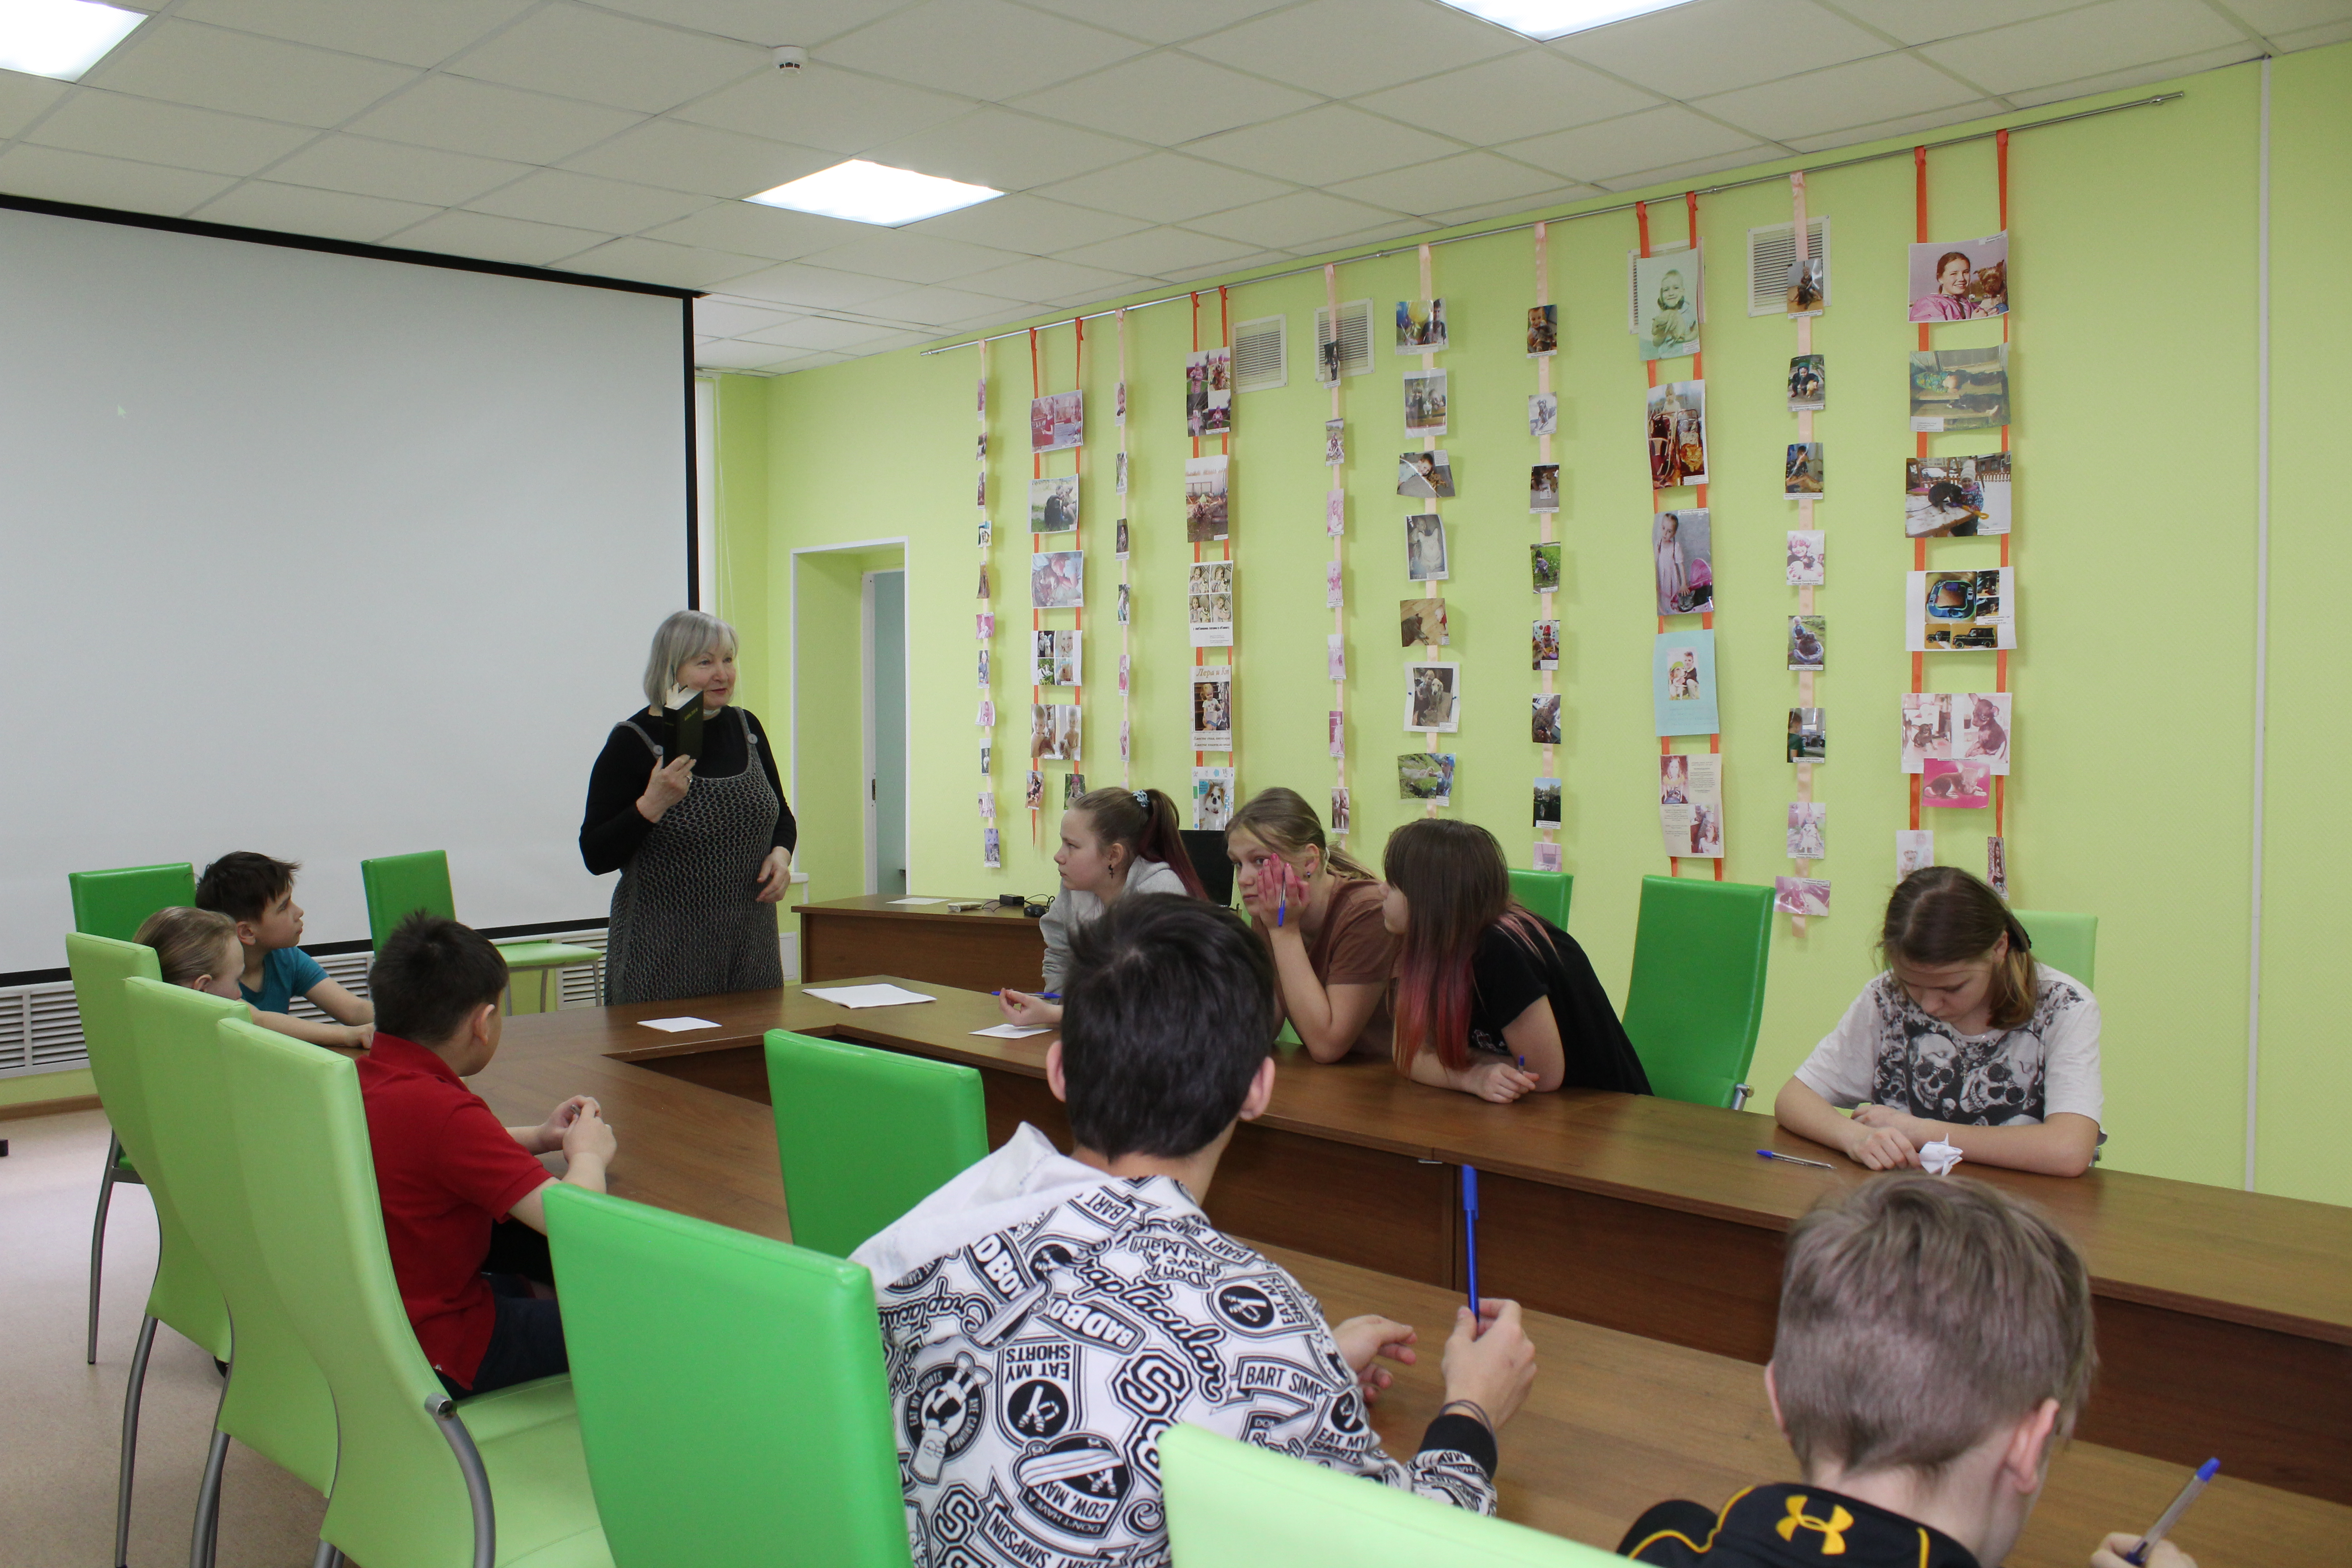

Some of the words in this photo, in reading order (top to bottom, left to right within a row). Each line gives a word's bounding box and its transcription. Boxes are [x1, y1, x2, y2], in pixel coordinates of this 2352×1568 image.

[1196, 668, 1215, 678] Лера
[1084, 1192, 1128, 1220] BART
[1185, 1247, 1211, 1260] ow
[1203, 1237, 1249, 1260] BART
[1046, 1298, 1136, 1347] BADBO
[1274, 1302, 1296, 1325] EAT
[1006, 1345, 1071, 1362] SHORTS
[1005, 1363, 1032, 1384] MY
[1039, 1363, 1070, 1381] EAT
[1246, 1366, 1286, 1387] BART
[1317, 1426, 1345, 1445] EAT
[1347, 1434, 1369, 1449] MY
[990, 1514, 1052, 1568] SIMPSON
